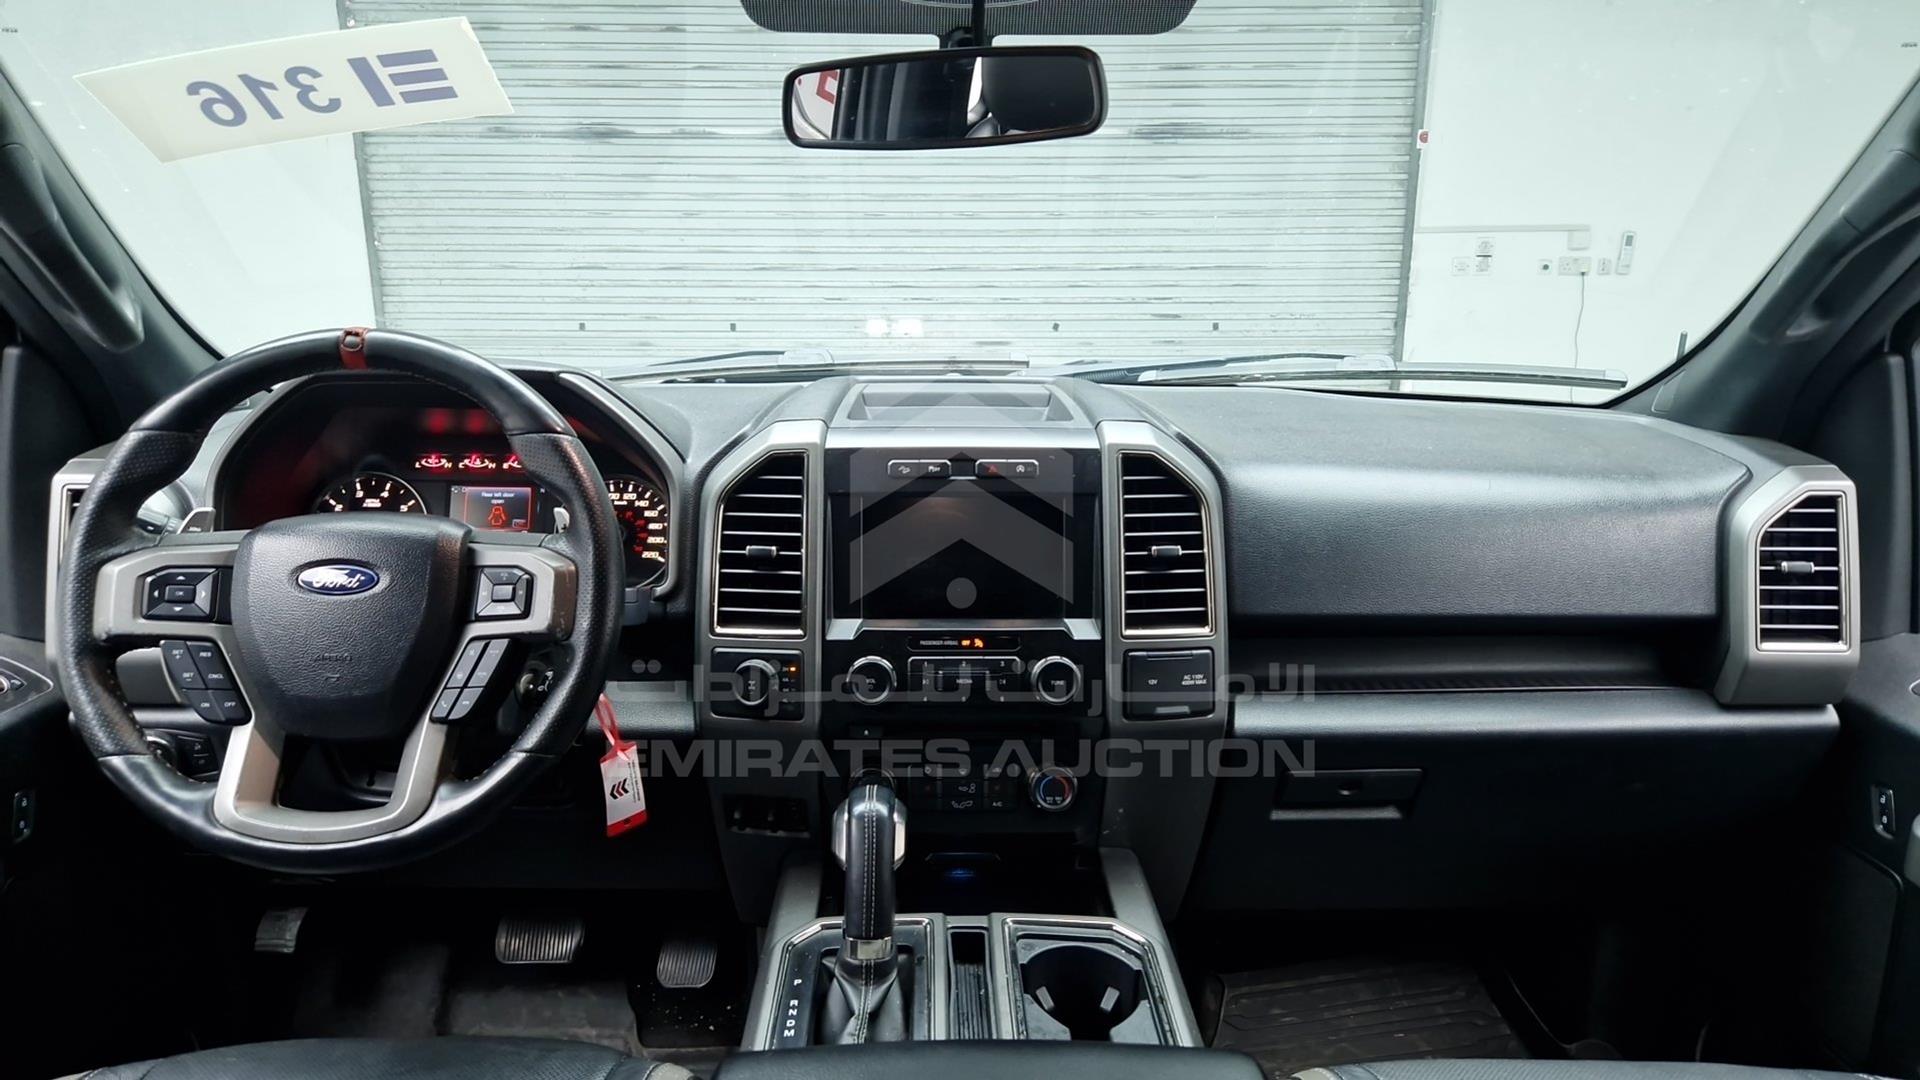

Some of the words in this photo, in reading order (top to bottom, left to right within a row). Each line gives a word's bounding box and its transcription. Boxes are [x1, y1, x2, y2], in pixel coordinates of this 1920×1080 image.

[646, 536, 664, 544] 200
[793, 978, 802, 986] P
[788, 1008, 798, 1016] N
[786, 1019, 796, 1027] D
[783, 1029, 795, 1037] M
